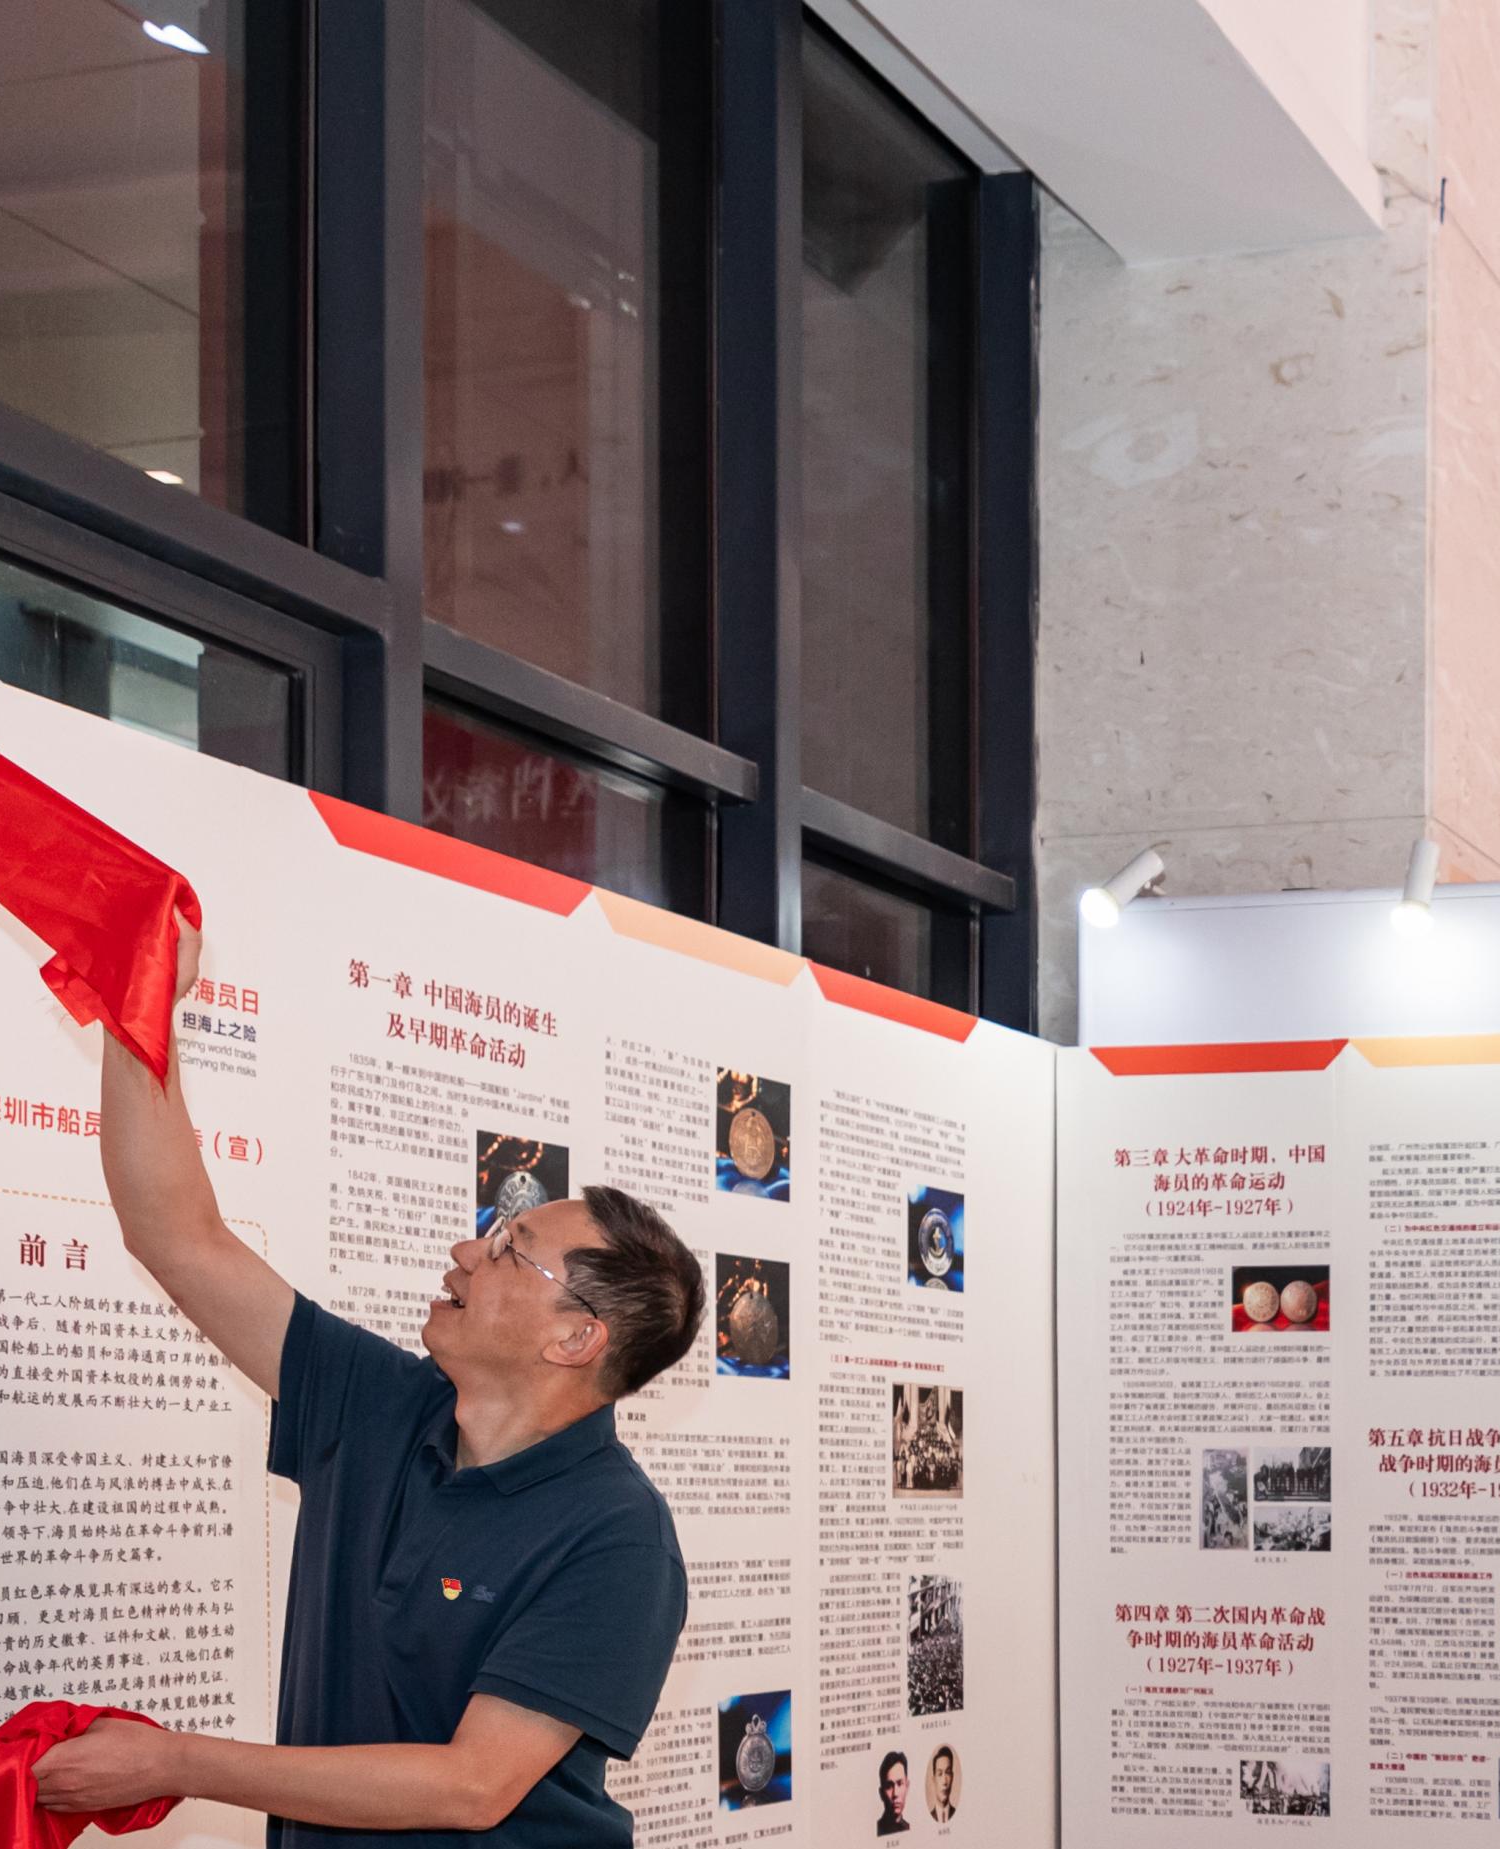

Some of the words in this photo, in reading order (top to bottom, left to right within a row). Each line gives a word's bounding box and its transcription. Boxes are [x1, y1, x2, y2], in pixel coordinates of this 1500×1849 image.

[183, 976, 259, 1016] 海员日
[348, 958, 414, 999] 第一章
[424, 979, 558, 1038] 中国海员的诞生
[182, 1011, 257, 1043] 担海上之险
[386, 1011, 526, 1070] 及早期革命活动
[1113, 1147, 1170, 1168] 第三章
[1153, 1171, 1285, 1193] 海员的革命运动
[1368, 1428, 1424, 1449] 第五章
[1114, 1604, 1171, 1624] 第四章
[1175, 1604, 1326, 1627] 第二次国内革命战
[1126, 1629, 1315, 1653] 争时期的海员革命活动
